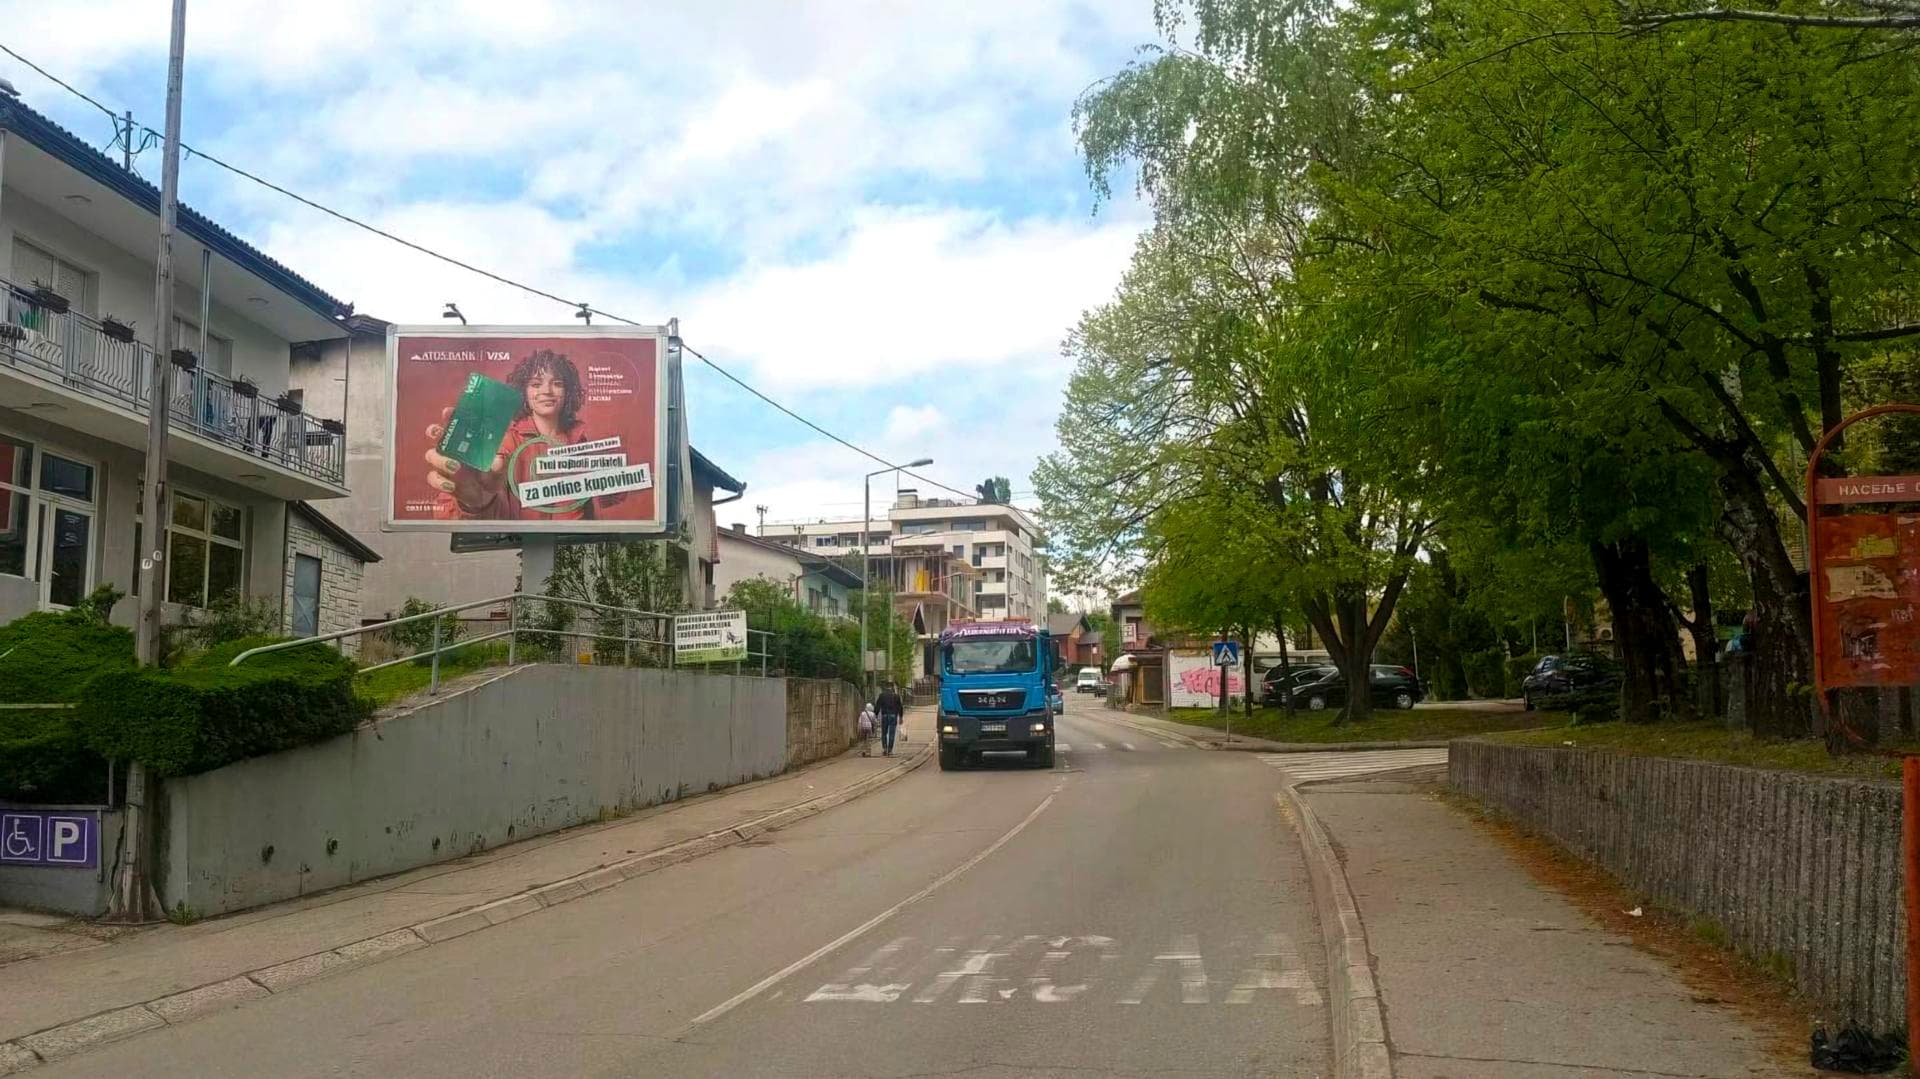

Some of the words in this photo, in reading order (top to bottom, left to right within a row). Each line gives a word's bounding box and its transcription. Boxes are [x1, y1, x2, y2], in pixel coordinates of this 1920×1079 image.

[486, 351, 511, 361] VISA
[525, 487, 540, 501] za
[542, 479, 582, 496] online
[583, 468, 646, 492] kupovinu!
[1839, 482, 1905, 496] НАСЕЉЕ
[54, 821, 80, 857] P
